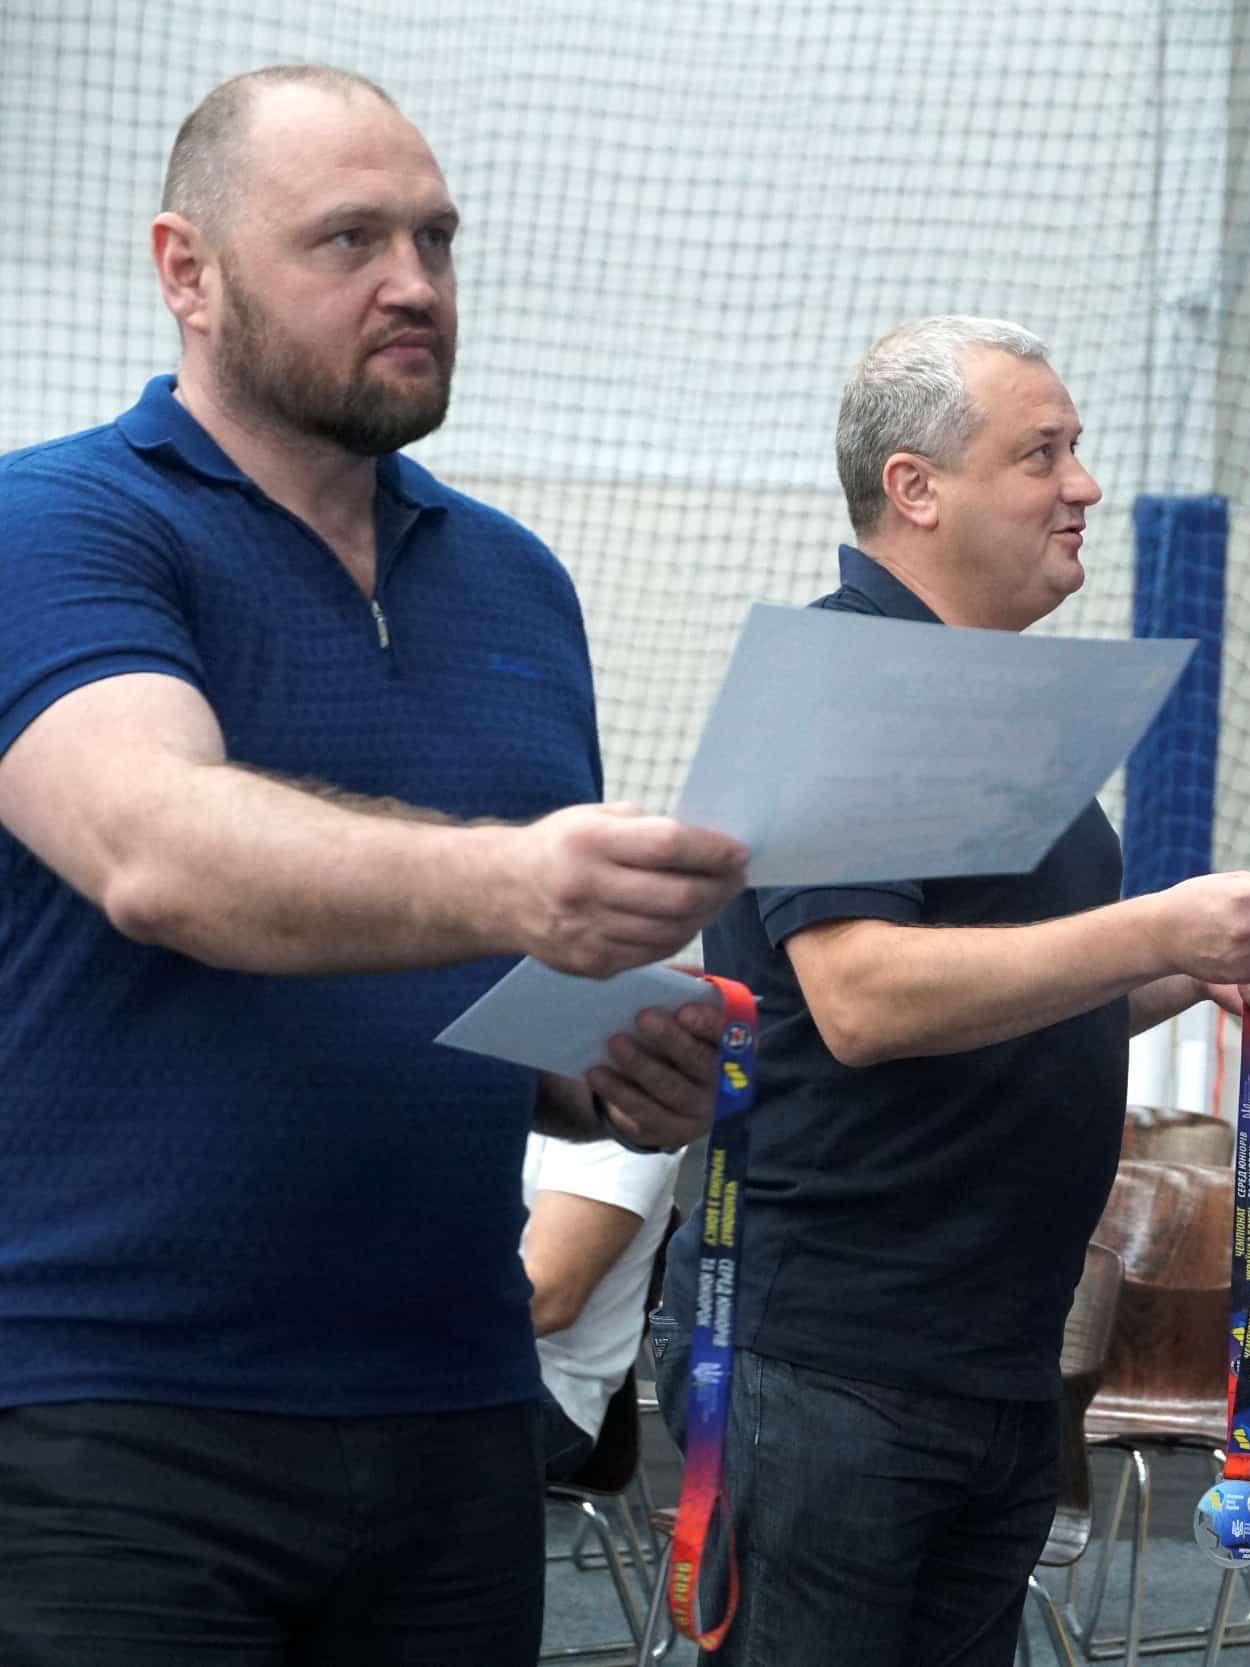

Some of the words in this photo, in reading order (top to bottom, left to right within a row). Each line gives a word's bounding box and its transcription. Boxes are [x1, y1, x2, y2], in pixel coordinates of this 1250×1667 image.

[1238, 1132, 1248, 1170] ЮНІОРІВ
[1237, 1172, 1247, 1198] СЕРЕД
[1235, 1206, 1246, 1257] ЧЕМПІОНАТ
